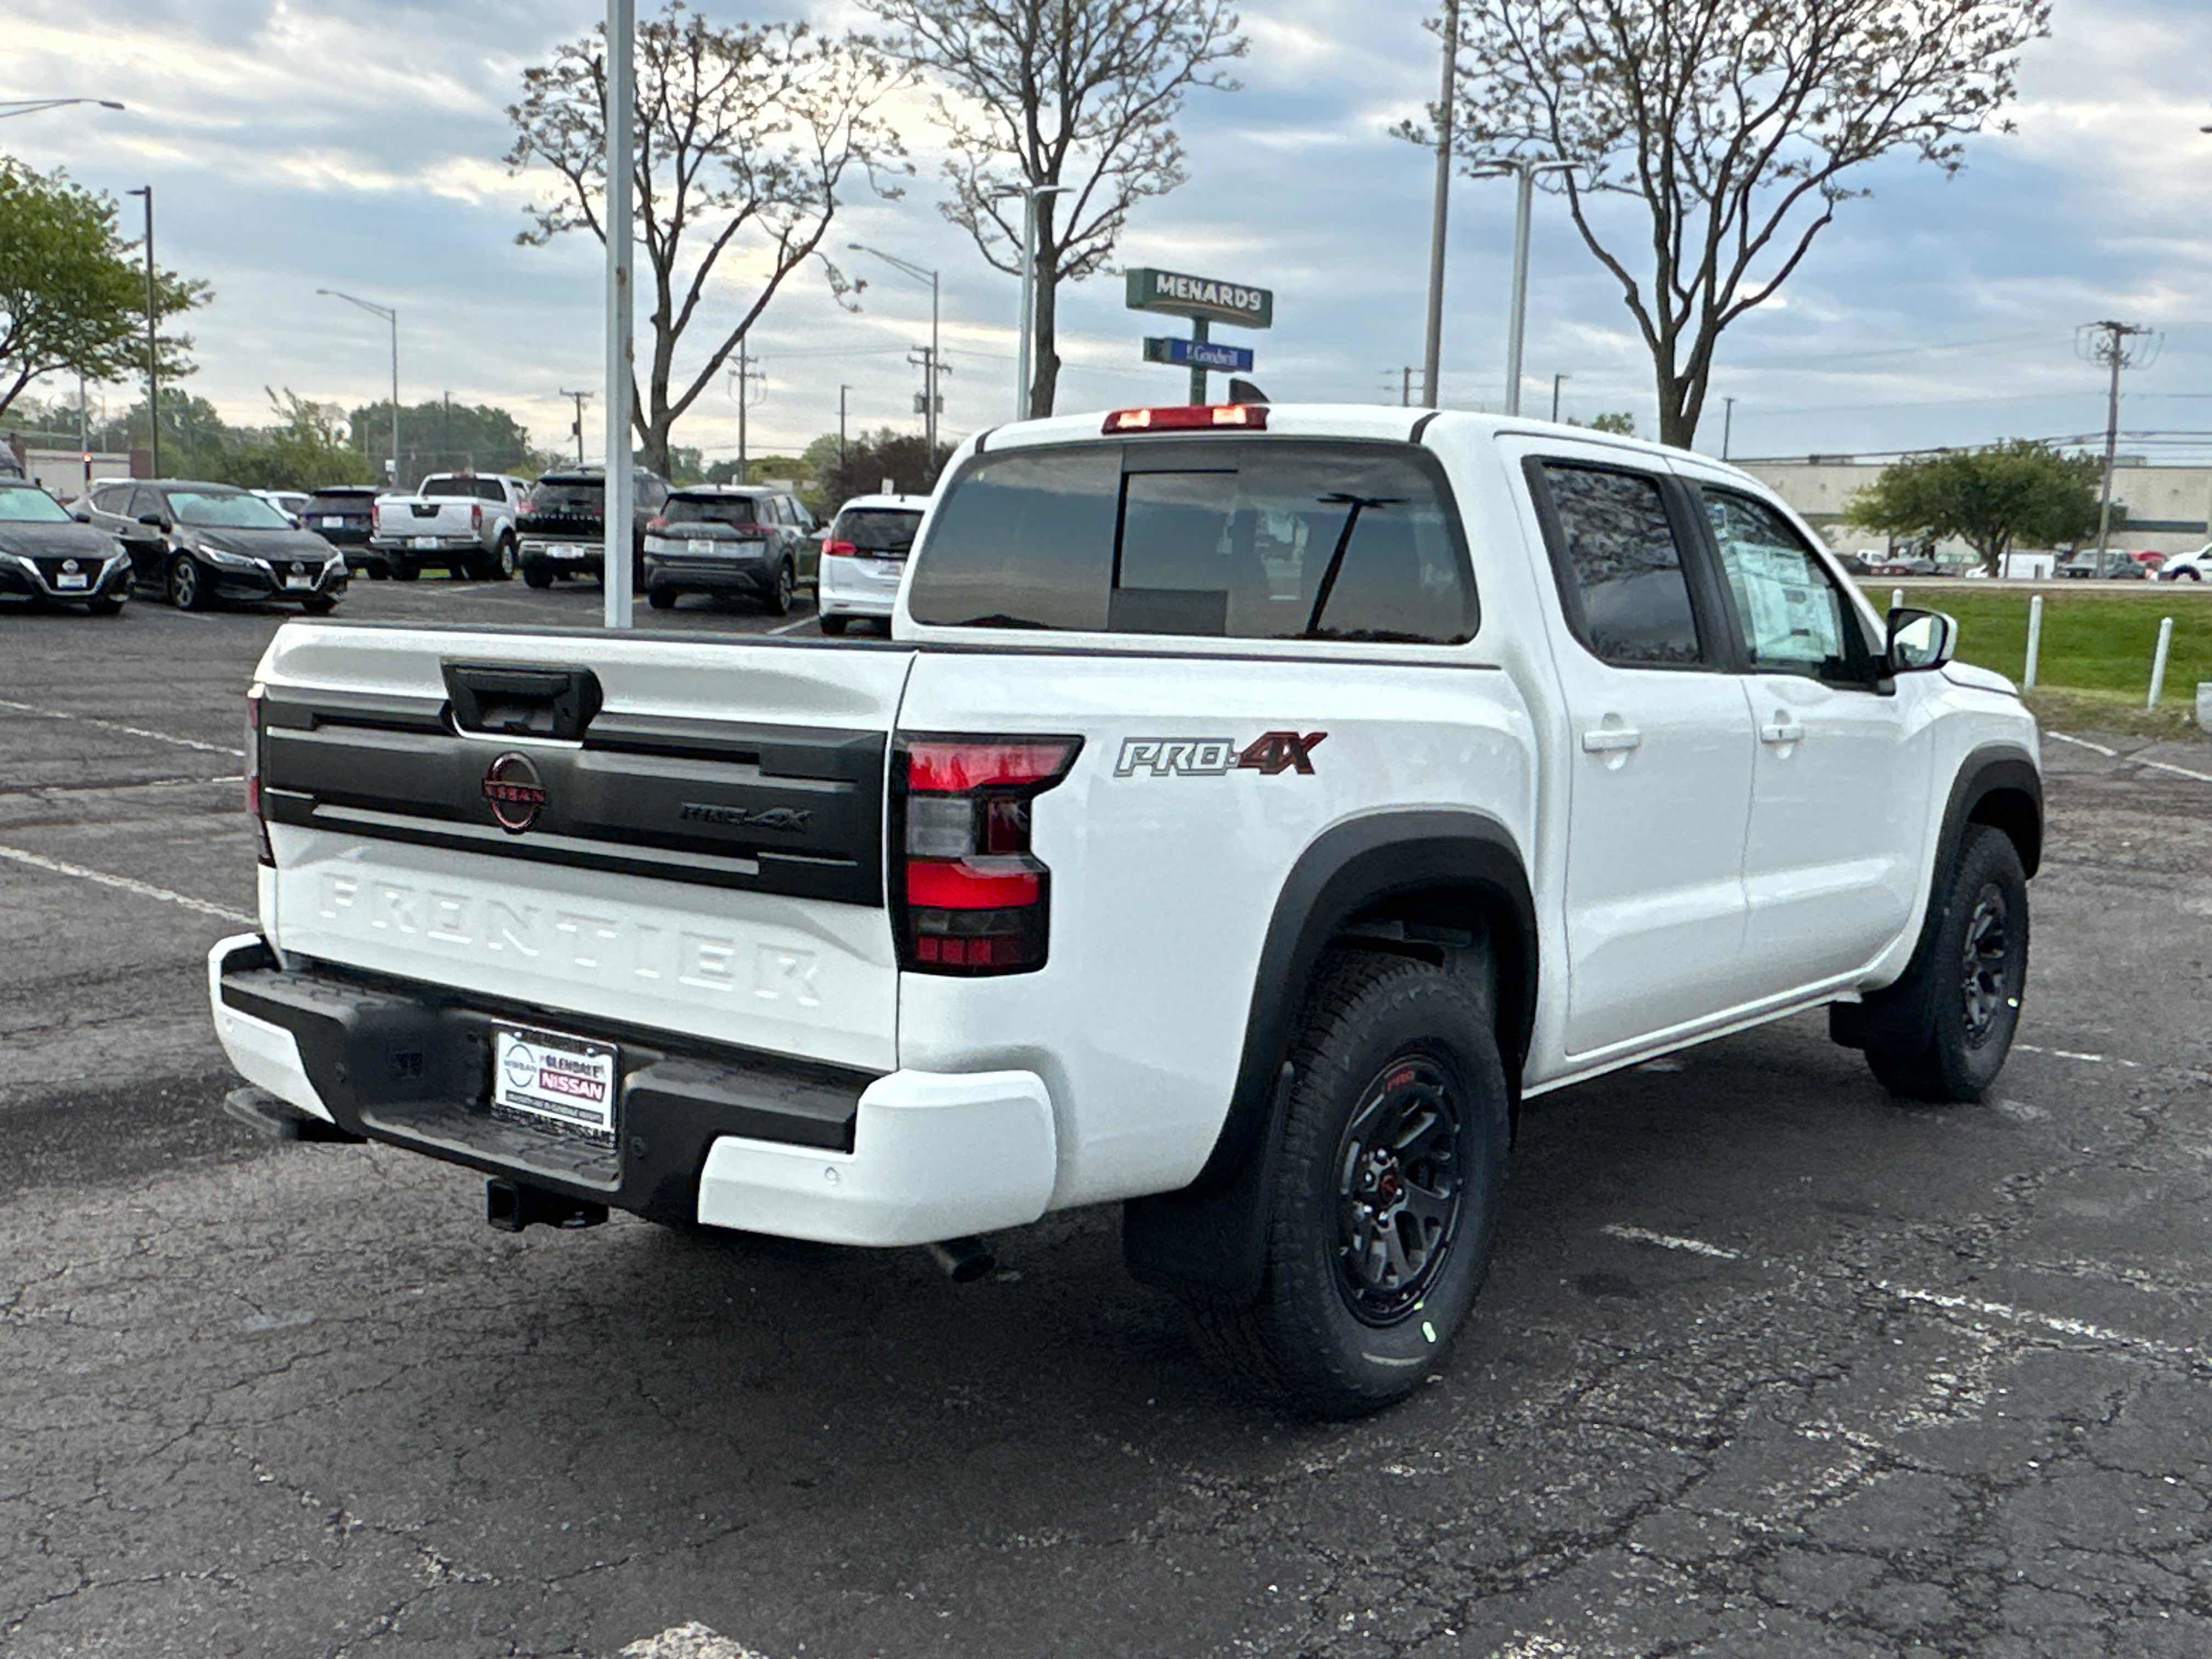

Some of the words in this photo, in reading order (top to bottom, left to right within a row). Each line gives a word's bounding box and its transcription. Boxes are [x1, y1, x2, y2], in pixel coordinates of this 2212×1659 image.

[1156, 274, 1261, 311] MENARDS
[1113, 731, 1328, 777] PRO-4X
[320, 872, 821, 1007] FRONTIER
[541, 1071, 603, 1101] NISSAN
